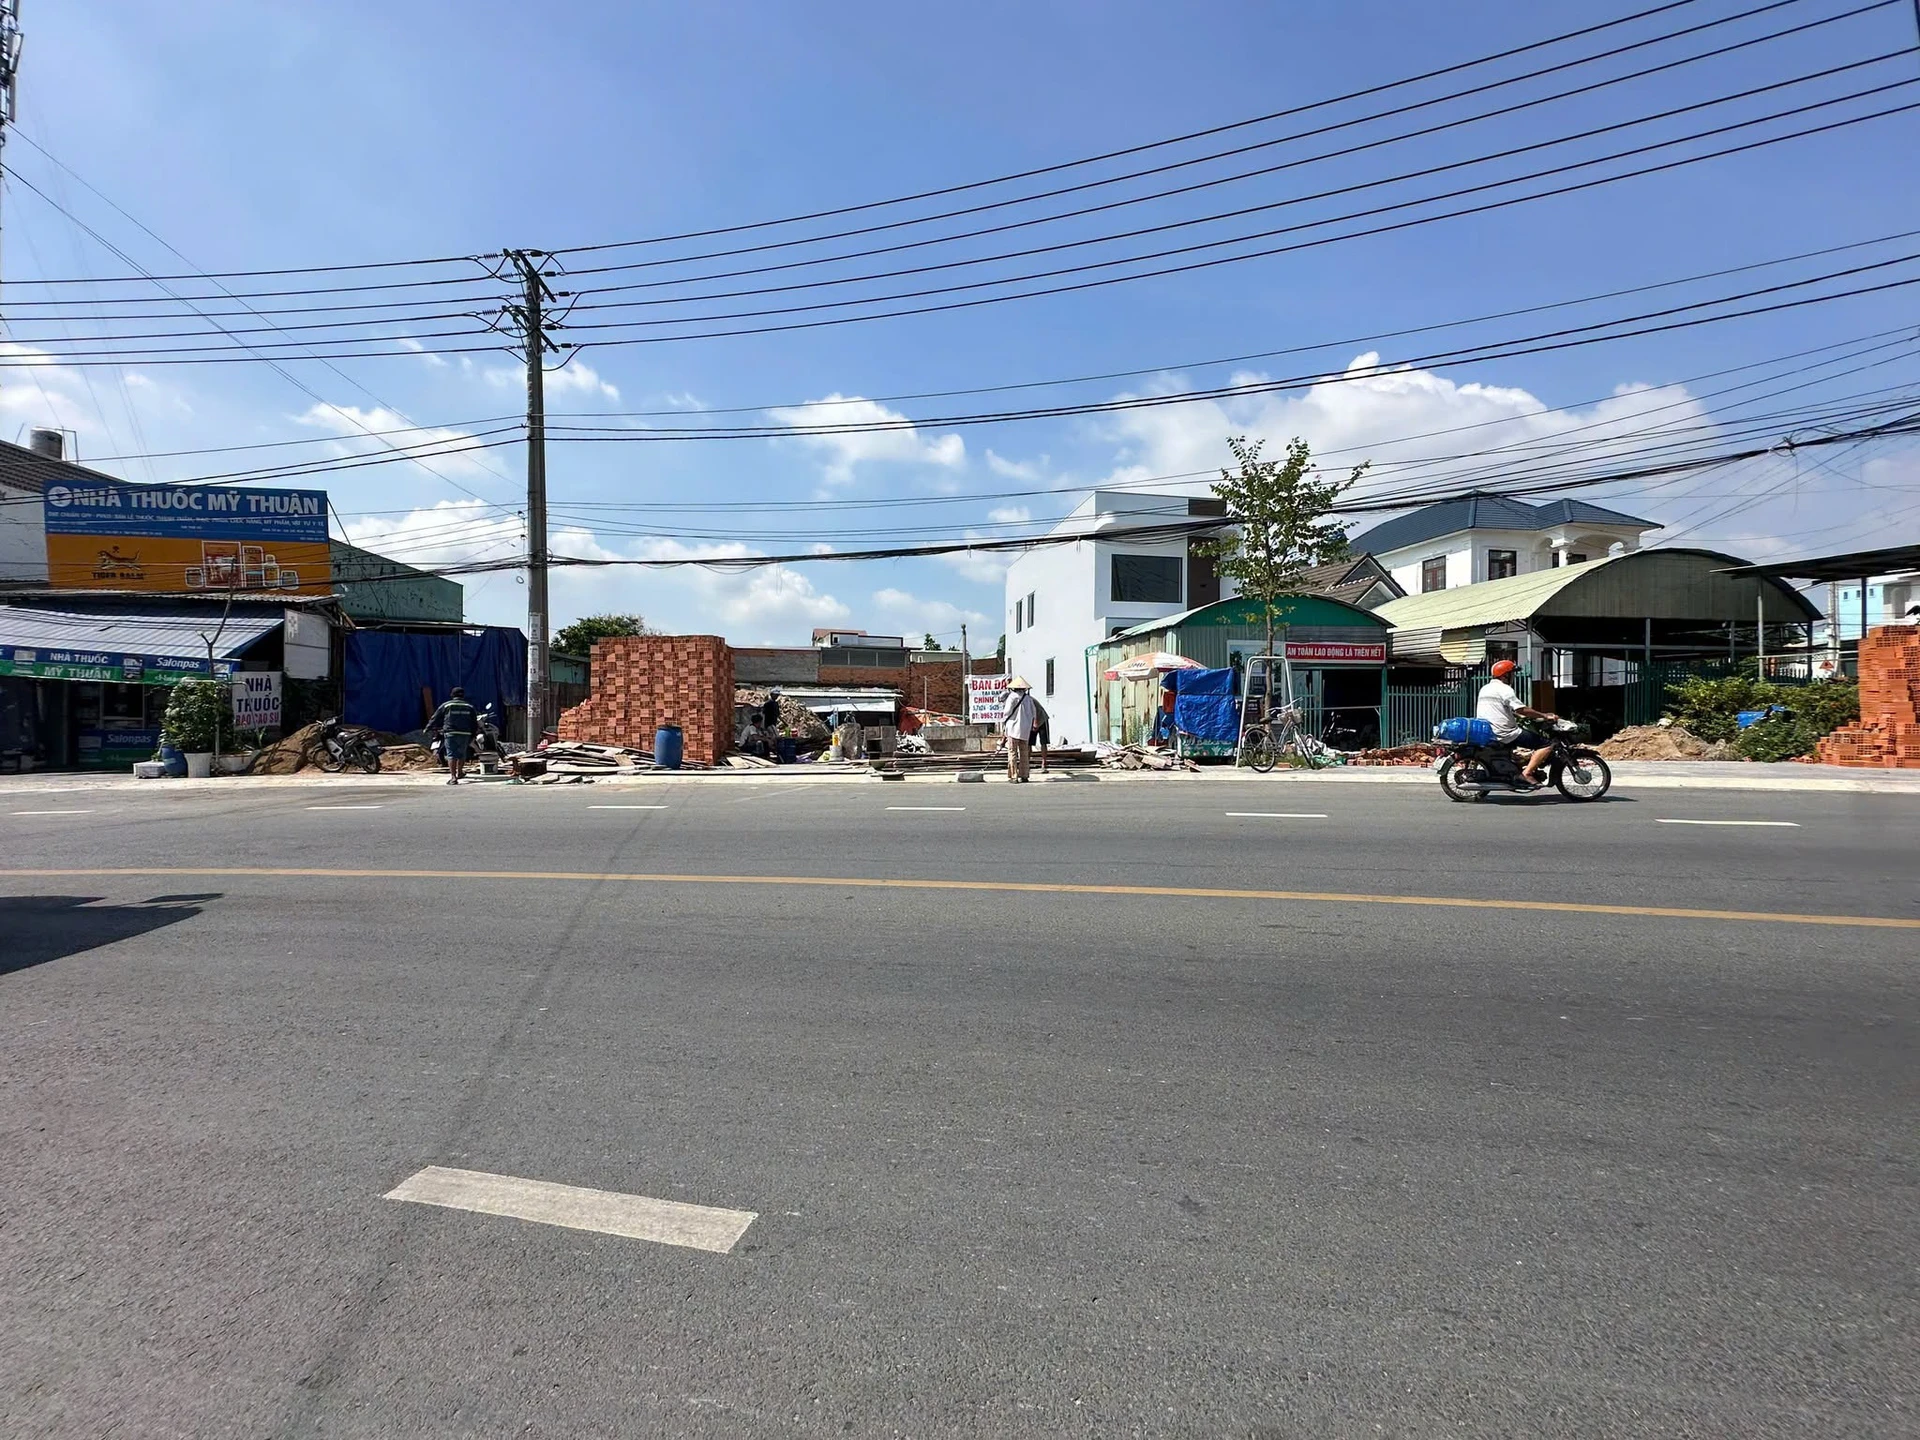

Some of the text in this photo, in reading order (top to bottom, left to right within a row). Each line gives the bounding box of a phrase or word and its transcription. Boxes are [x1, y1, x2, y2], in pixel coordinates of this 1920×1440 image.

[73, 486, 318, 517] NHÀ THUỐC MỸ THUẬN
[1287, 647, 1296, 656] AN
[1314, 647, 1326, 656] LAO
[50, 652, 109, 664] NHÀ THUỐC
[156, 657, 200, 670] Salonpas
[44, 665, 63, 676] MỸ
[245, 674, 272, 692] NHÀ
[236, 692, 280, 713] THUỐC
[269, 711, 279, 723] SU
[106, 733, 152, 744] Salonpas
